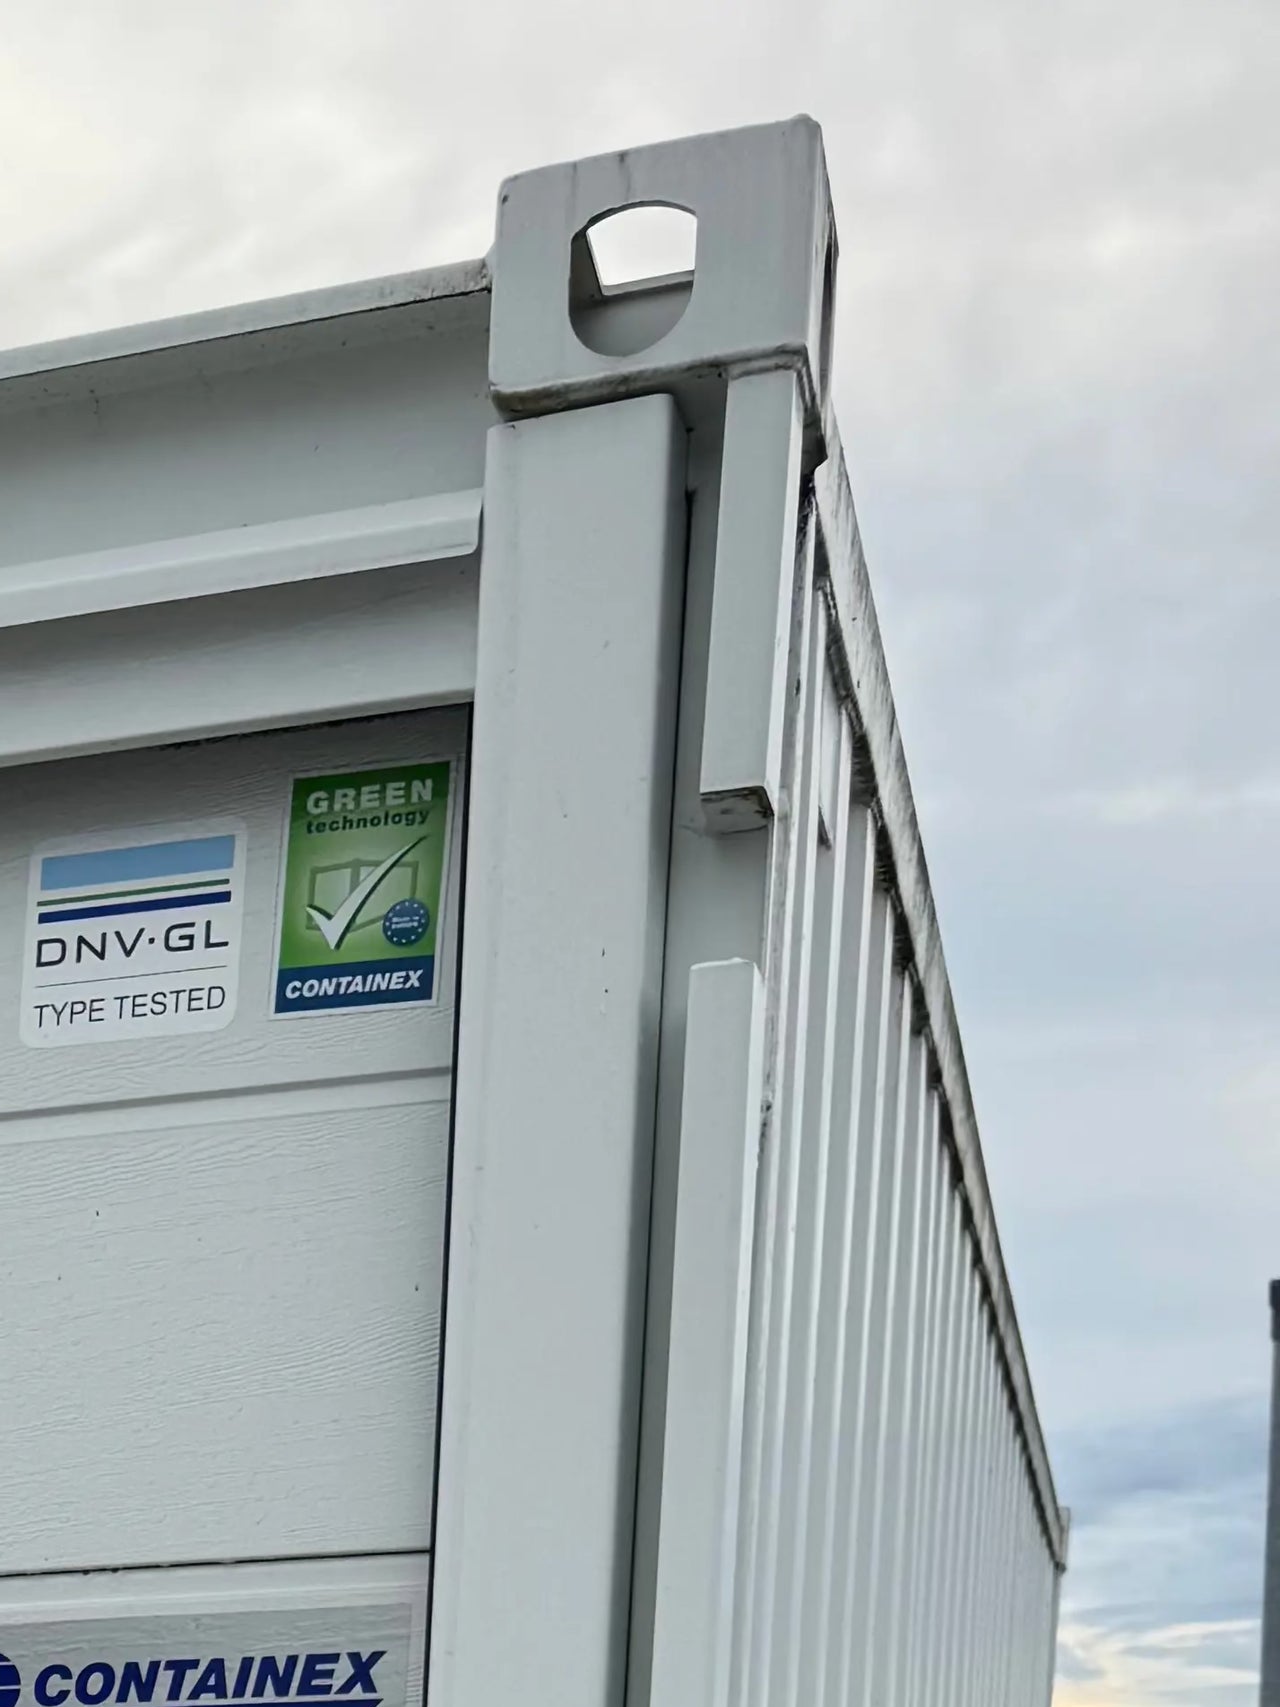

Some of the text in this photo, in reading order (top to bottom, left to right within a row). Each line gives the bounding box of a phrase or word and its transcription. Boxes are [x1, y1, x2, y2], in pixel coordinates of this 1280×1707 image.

[306, 778, 434, 815] GREEN
[306, 808, 431, 834] technology
[284, 969, 424, 1000] CONTAINEX
[33, 985, 226, 1029] TYPE TESTED
[34, 1650, 388, 1707] CONTAINEX
